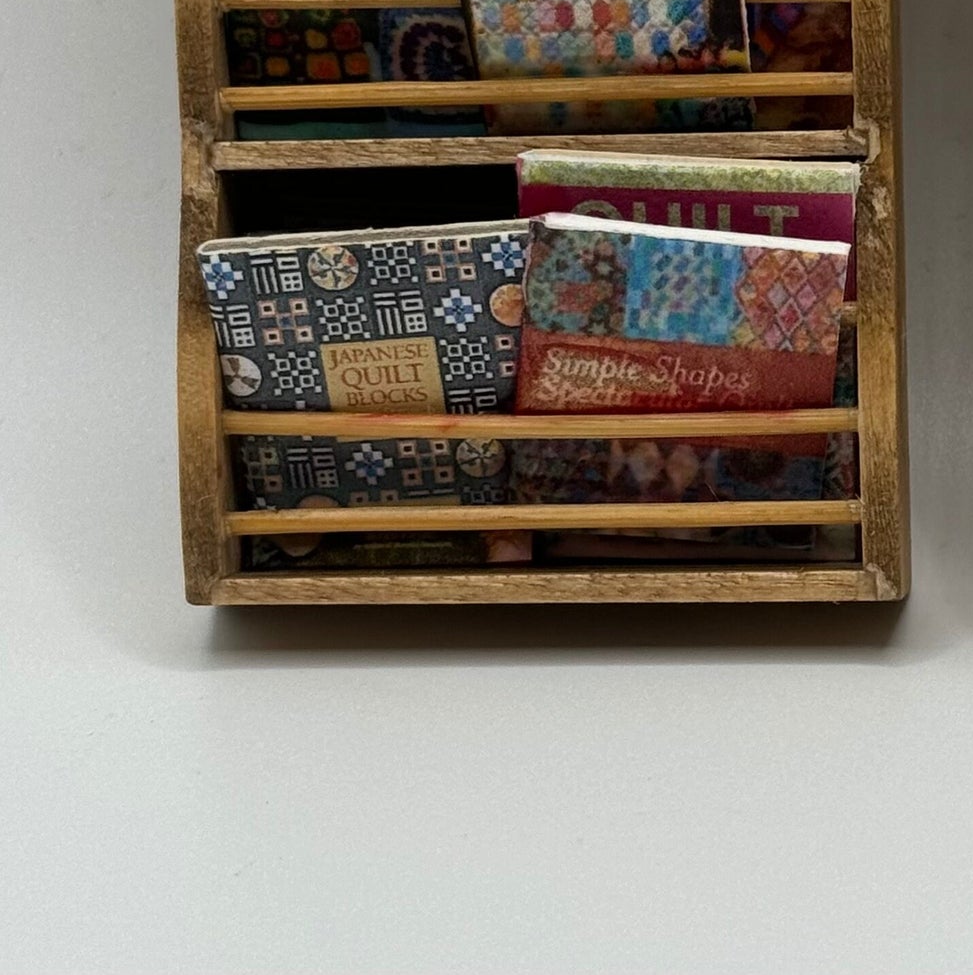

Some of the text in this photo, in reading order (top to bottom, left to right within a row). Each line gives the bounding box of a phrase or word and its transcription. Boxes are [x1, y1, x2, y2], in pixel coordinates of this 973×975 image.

[327, 343, 430, 371] JAPANESE
[545, 346, 753, 396] Simple Shapes
[341, 362, 425, 391] QUILT
[345, 386, 428, 407] BLOCKS
